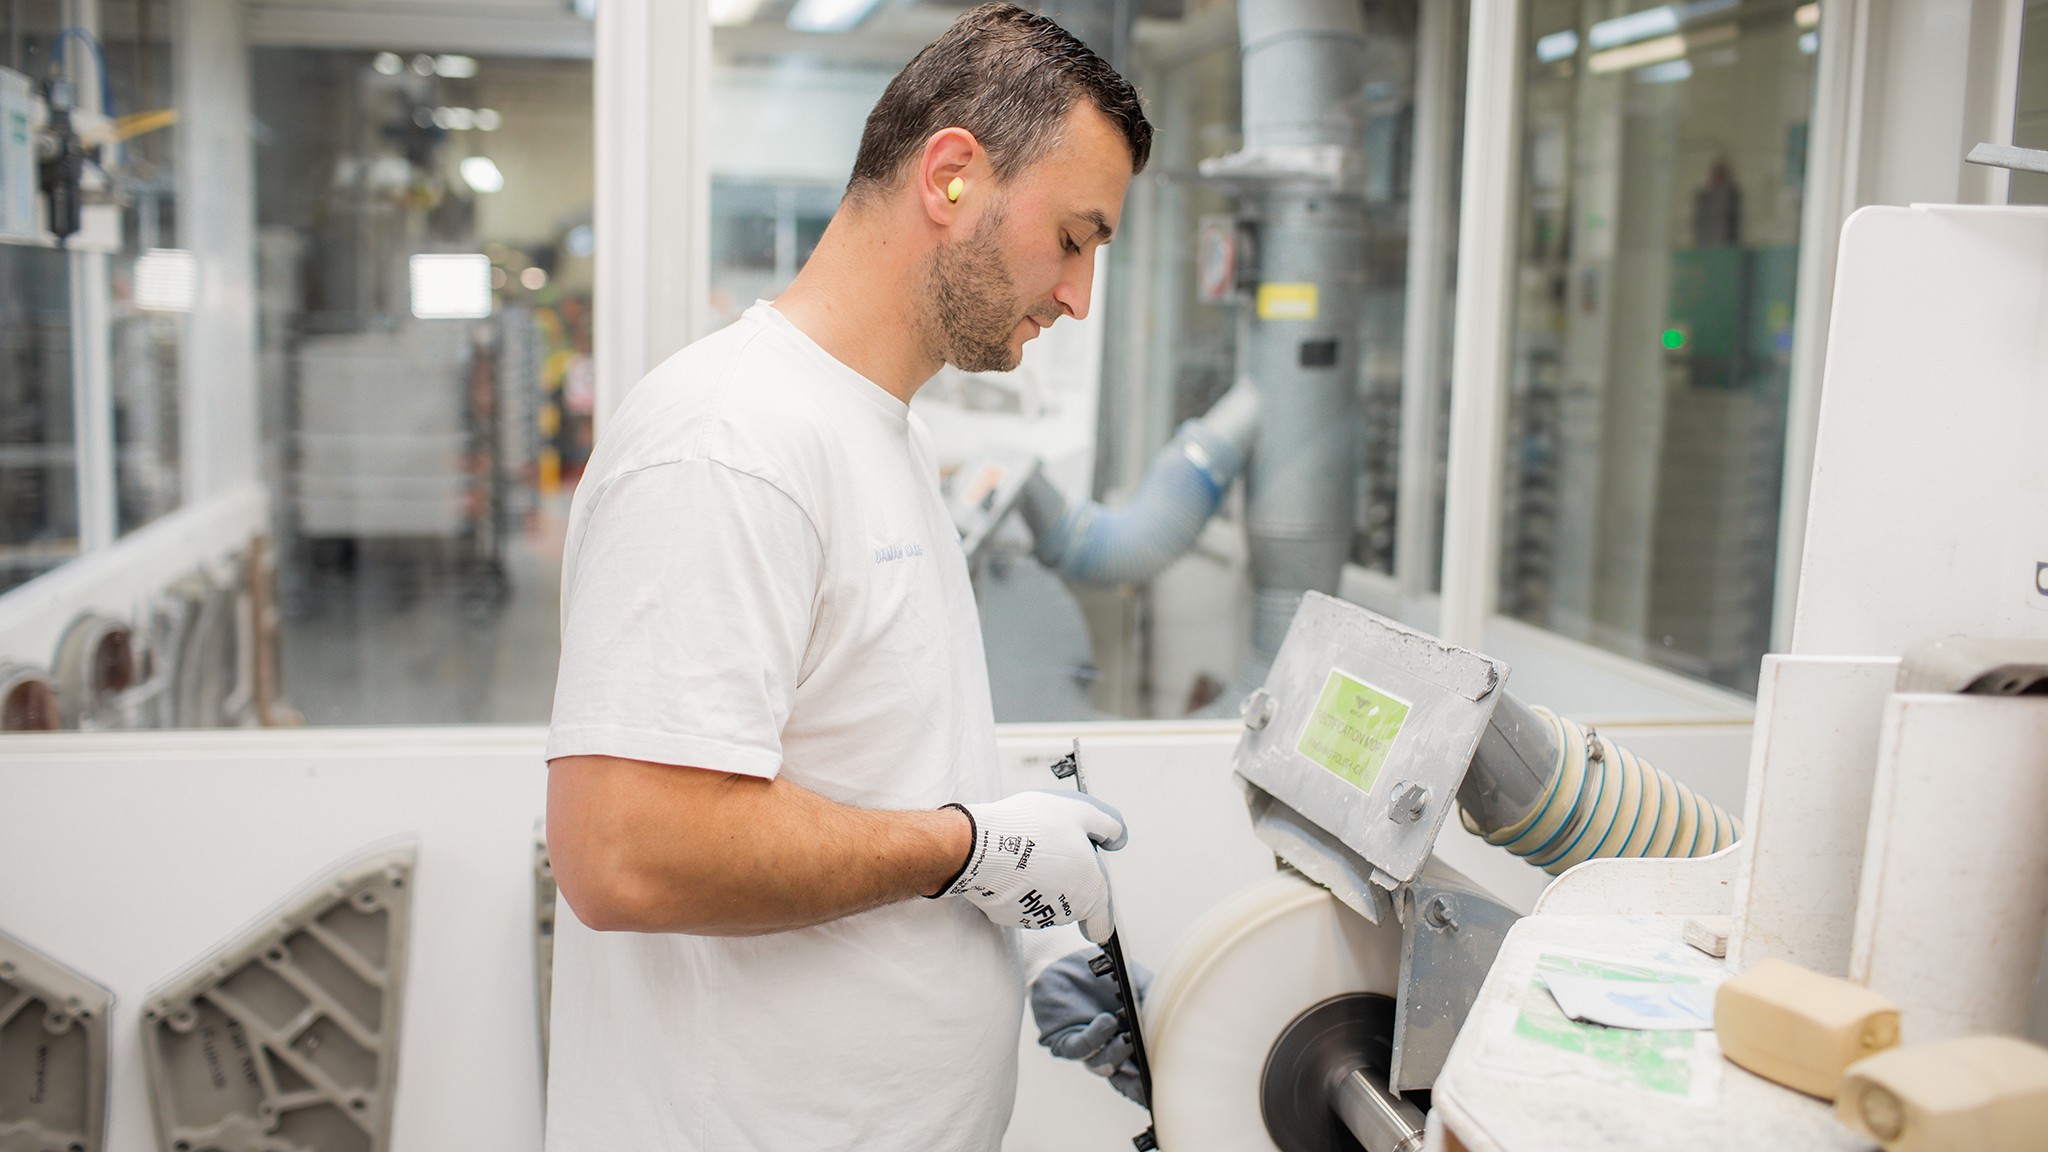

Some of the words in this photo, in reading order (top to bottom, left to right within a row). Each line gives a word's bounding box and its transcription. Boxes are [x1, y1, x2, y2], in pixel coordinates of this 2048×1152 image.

[1018, 840, 1036, 870] Ansell
[1018, 889, 1056, 929] HyFle
[1058, 894, 1072, 917] 11-800
